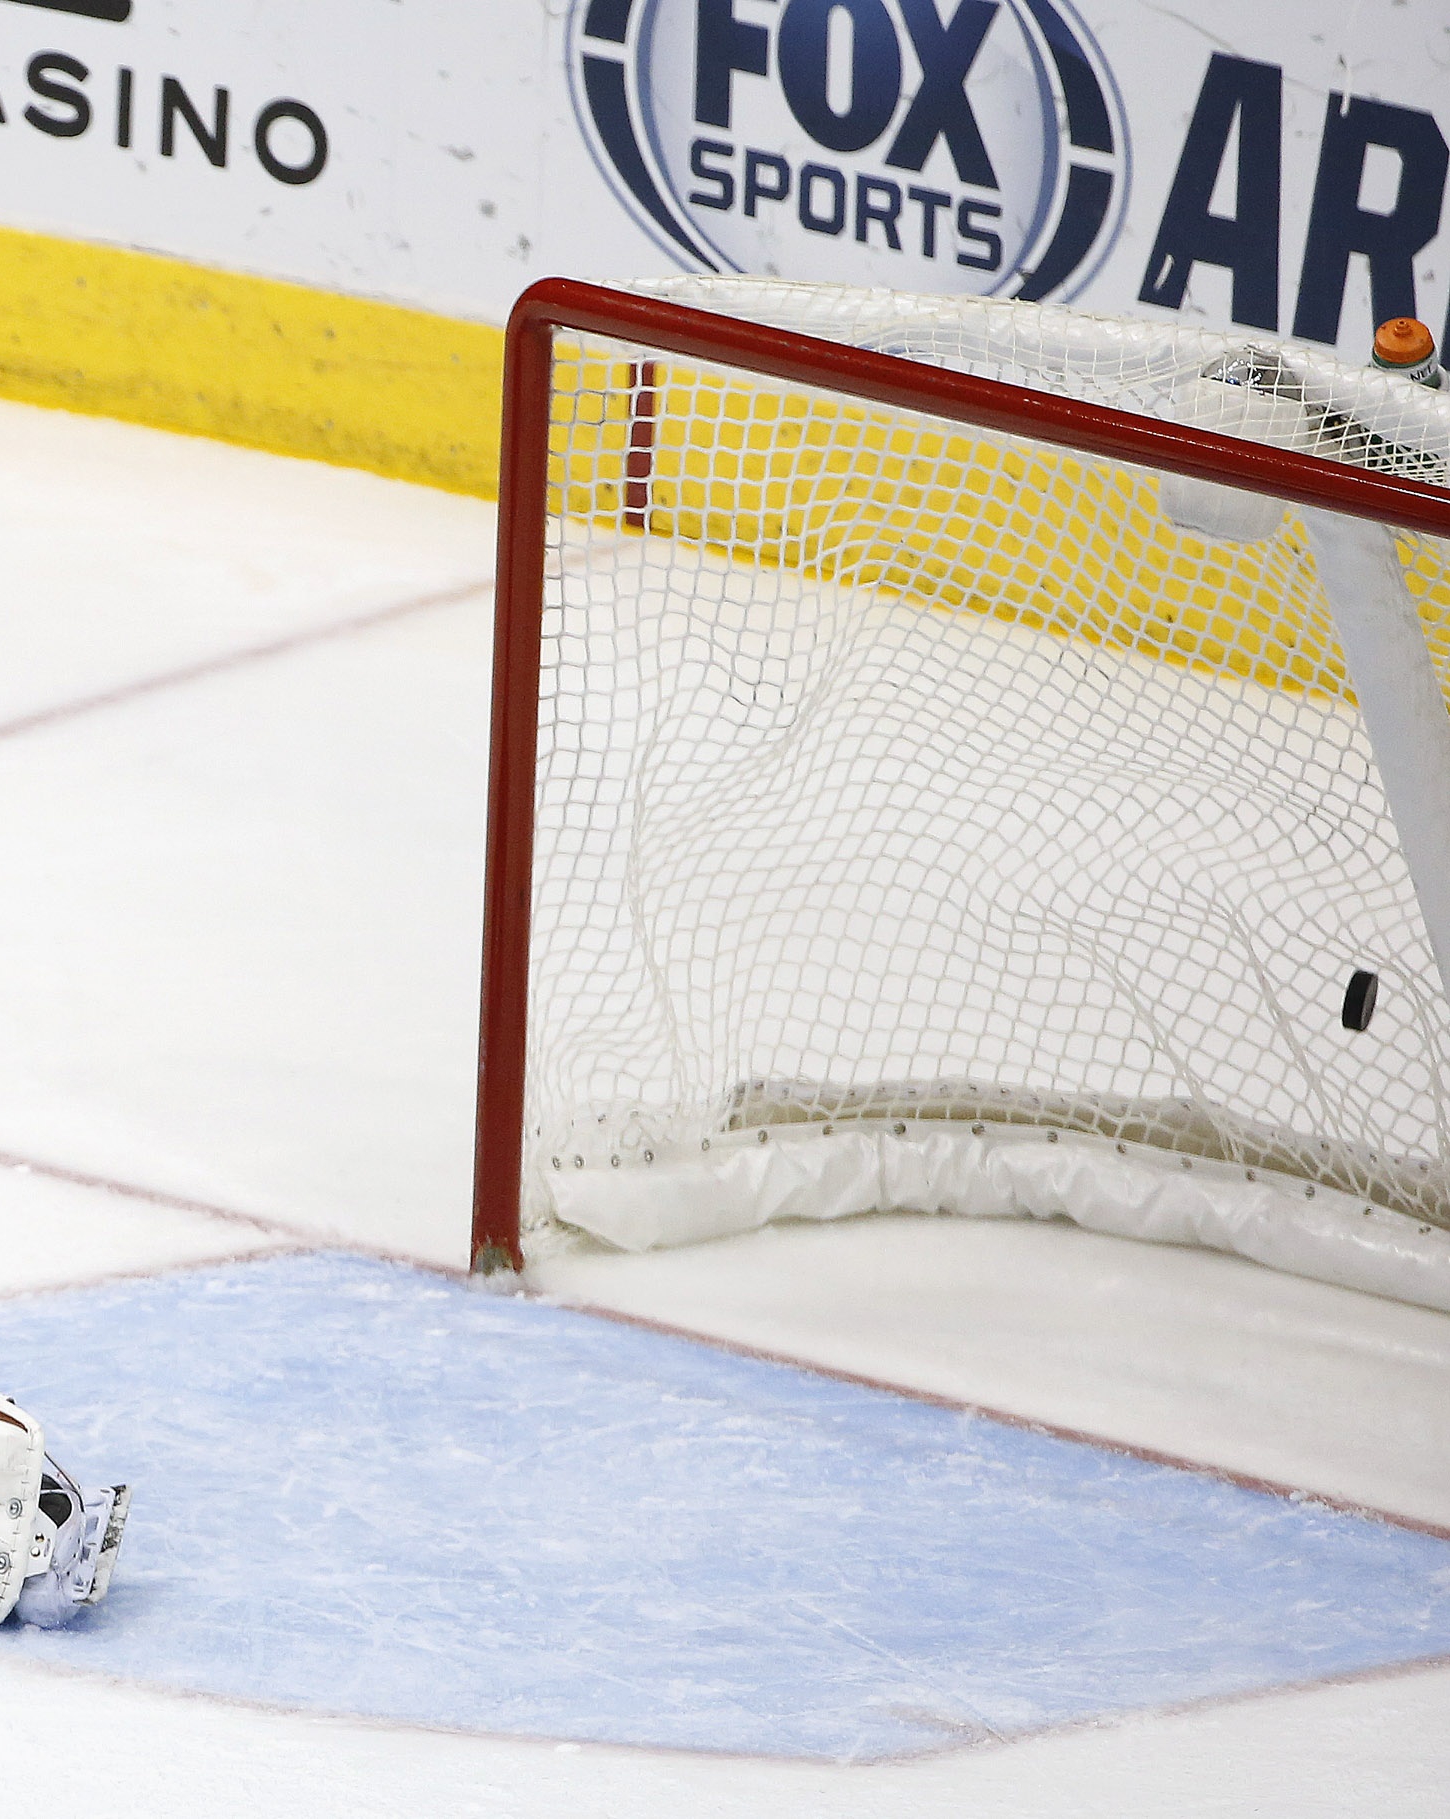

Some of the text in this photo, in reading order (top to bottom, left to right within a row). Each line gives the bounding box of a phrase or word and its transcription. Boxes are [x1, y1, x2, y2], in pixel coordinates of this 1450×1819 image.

[695, 0, 1000, 190] FOX
[689, 136, 1002, 271] SPORTS
[1137, 50, 1450, 346] AR
